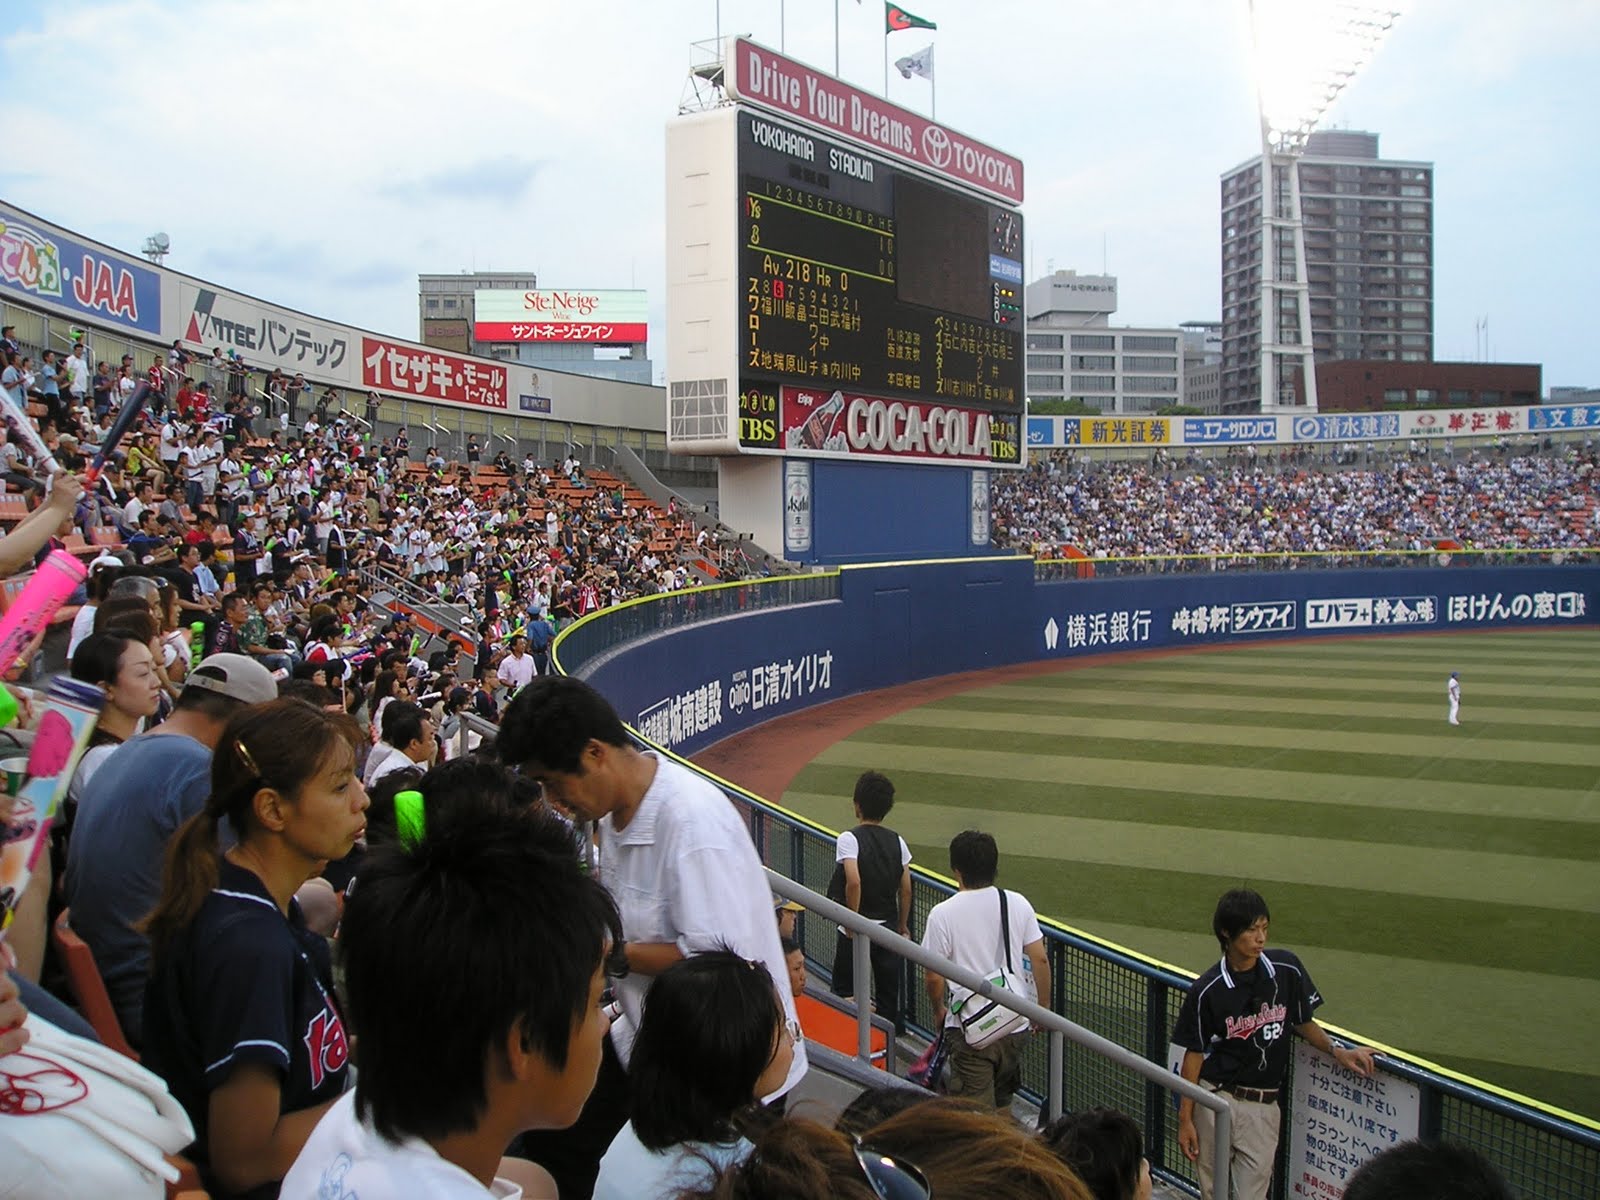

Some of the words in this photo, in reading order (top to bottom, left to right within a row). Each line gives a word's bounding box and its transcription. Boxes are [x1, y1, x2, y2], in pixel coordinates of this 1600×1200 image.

[750, 51, 801, 109] Drive
[805, 75, 846, 126] Your
[851, 94, 917, 155] Dreams.
[751, 120, 814, 162] YOKOHAMA
[829, 149, 874, 183] STADIUM
[953, 142, 1016, 191] TOYOTA
[73, 254, 138, 322] JAA
[258, 318, 347, 370] バンテック
[511, 324, 614, 340] サントネージュワイン
[738, 417, 776, 441] TBS
[1092, 420, 1166, 443] 新光証券
[1323, 416, 1398, 439] 清水建設
[991, 440, 1017, 459] TBS
[1172, 605, 1231, 636] 崎陽軒
[1234, 604, 1292, 631] シウマイ
[1374, 597, 1435, 624] 黄金の味
[1448, 591, 1577, 622] ほけんの窓口
[1067, 610, 1152, 648] 横浜銀行
[752, 650, 833, 711] 日清オイリオ
[670, 680, 722, 745] 城南建設
[1263, 1022, 1281, 1041] 62
[1309, 1073, 1397, 1117] 十分ご注意下さい
[1305, 1151, 1348, 1180] 禁止です
